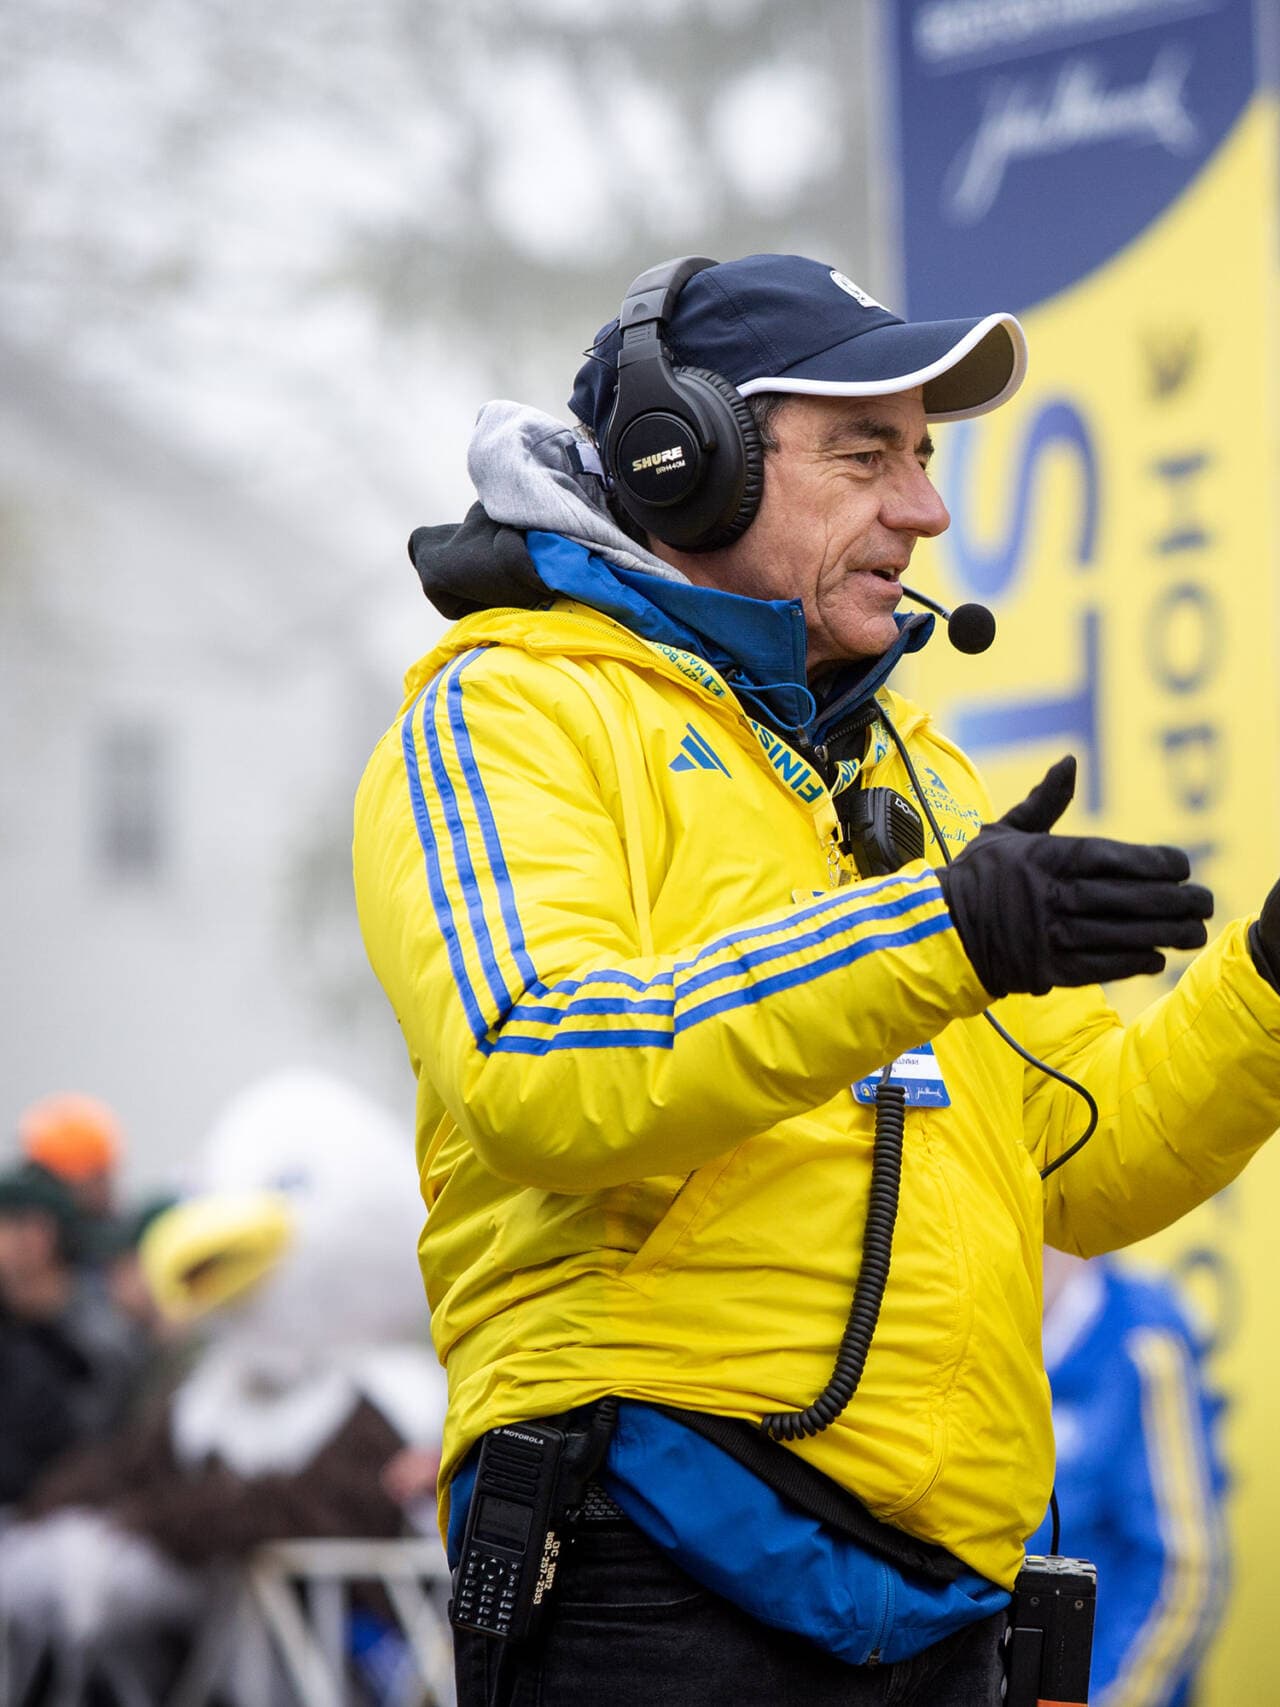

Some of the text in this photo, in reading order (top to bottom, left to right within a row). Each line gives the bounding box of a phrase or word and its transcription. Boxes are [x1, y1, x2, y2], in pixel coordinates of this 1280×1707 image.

[632, 446, 683, 472] SHURE
[751, 720, 824, 804] FINIS
[502, 1429, 544, 1445] MOTOROLA
[533, 1531, 555, 1605] 800-257-2333
